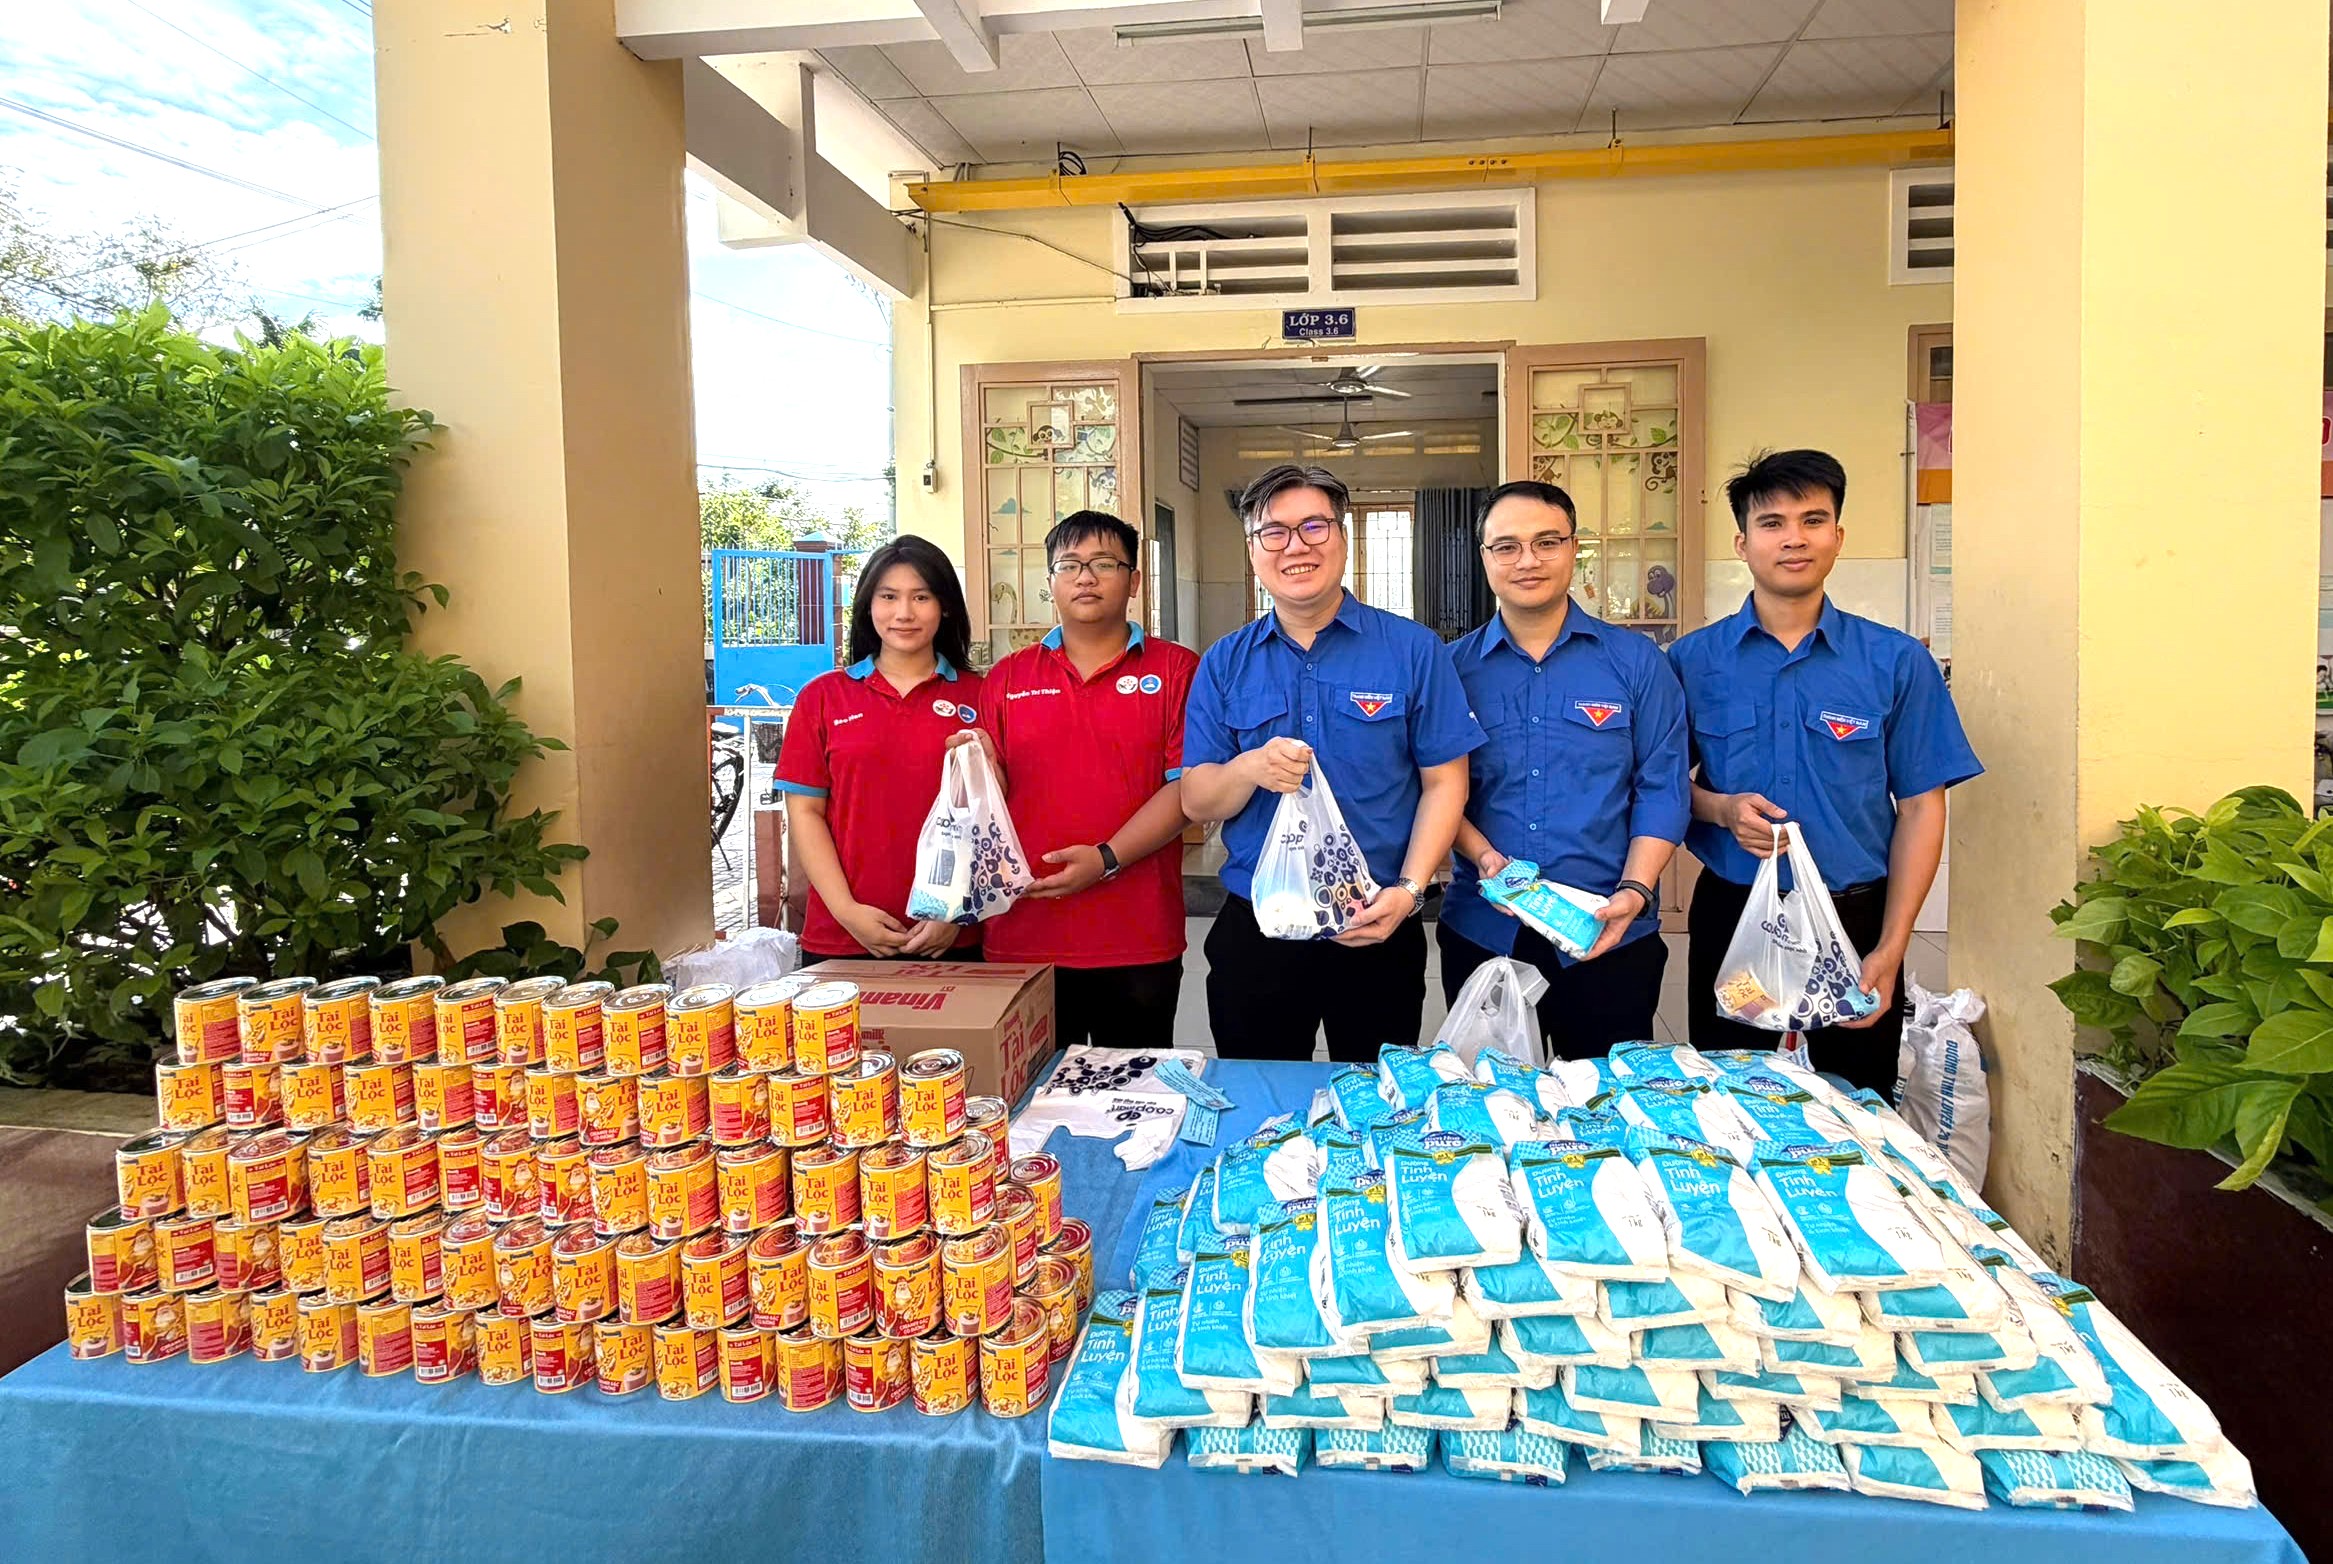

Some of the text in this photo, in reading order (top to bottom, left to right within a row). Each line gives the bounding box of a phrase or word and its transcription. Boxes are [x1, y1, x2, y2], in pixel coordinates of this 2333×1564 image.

[1290, 313, 1348, 326] LỚP 3.6
[1299, 327, 1339, 336] Class 3.6
[860, 991, 948, 1010] Vinam
[755, 1015, 776, 1029] Tài
[755, 1027, 779, 1042] Lộc
[1000, 1022, 1025, 1072] Tài
[853, 1089, 873, 1103] Tài
[914, 1089, 935, 1102] Tài
[853, 1100, 877, 1115] Lộc
[915, 1100, 937, 1114] Lộc
[614, 1172, 636, 1187] Tài
[1664, 1166, 1701, 1180] Tinh
[940, 1175, 961, 1189] Tài
[1669, 1179, 1721, 1198] Luyện
[614, 1184, 640, 1200] Lộc
[940, 1188, 963, 1203] Lộc
[575, 1262, 599, 1278] Tài
[690, 1271, 711, 1284] Tài
[1198, 1271, 1228, 1283] Tinh
[575, 1274, 601, 1291] Lộc
[690, 1282, 714, 1297] Lộc
[955, 1276, 976, 1289] Tài
[1196, 1281, 1241, 1296] Luyện
[955, 1288, 979, 1304] Lộc
[664, 1343, 685, 1356] Tài
[664, 1354, 689, 1370] Lộc
[934, 1355, 957, 1369] Tài
[994, 1357, 1016, 1371] Tài
[934, 1366, 959, 1381] Lộc
[995, 1369, 1018, 1385] Lộc
